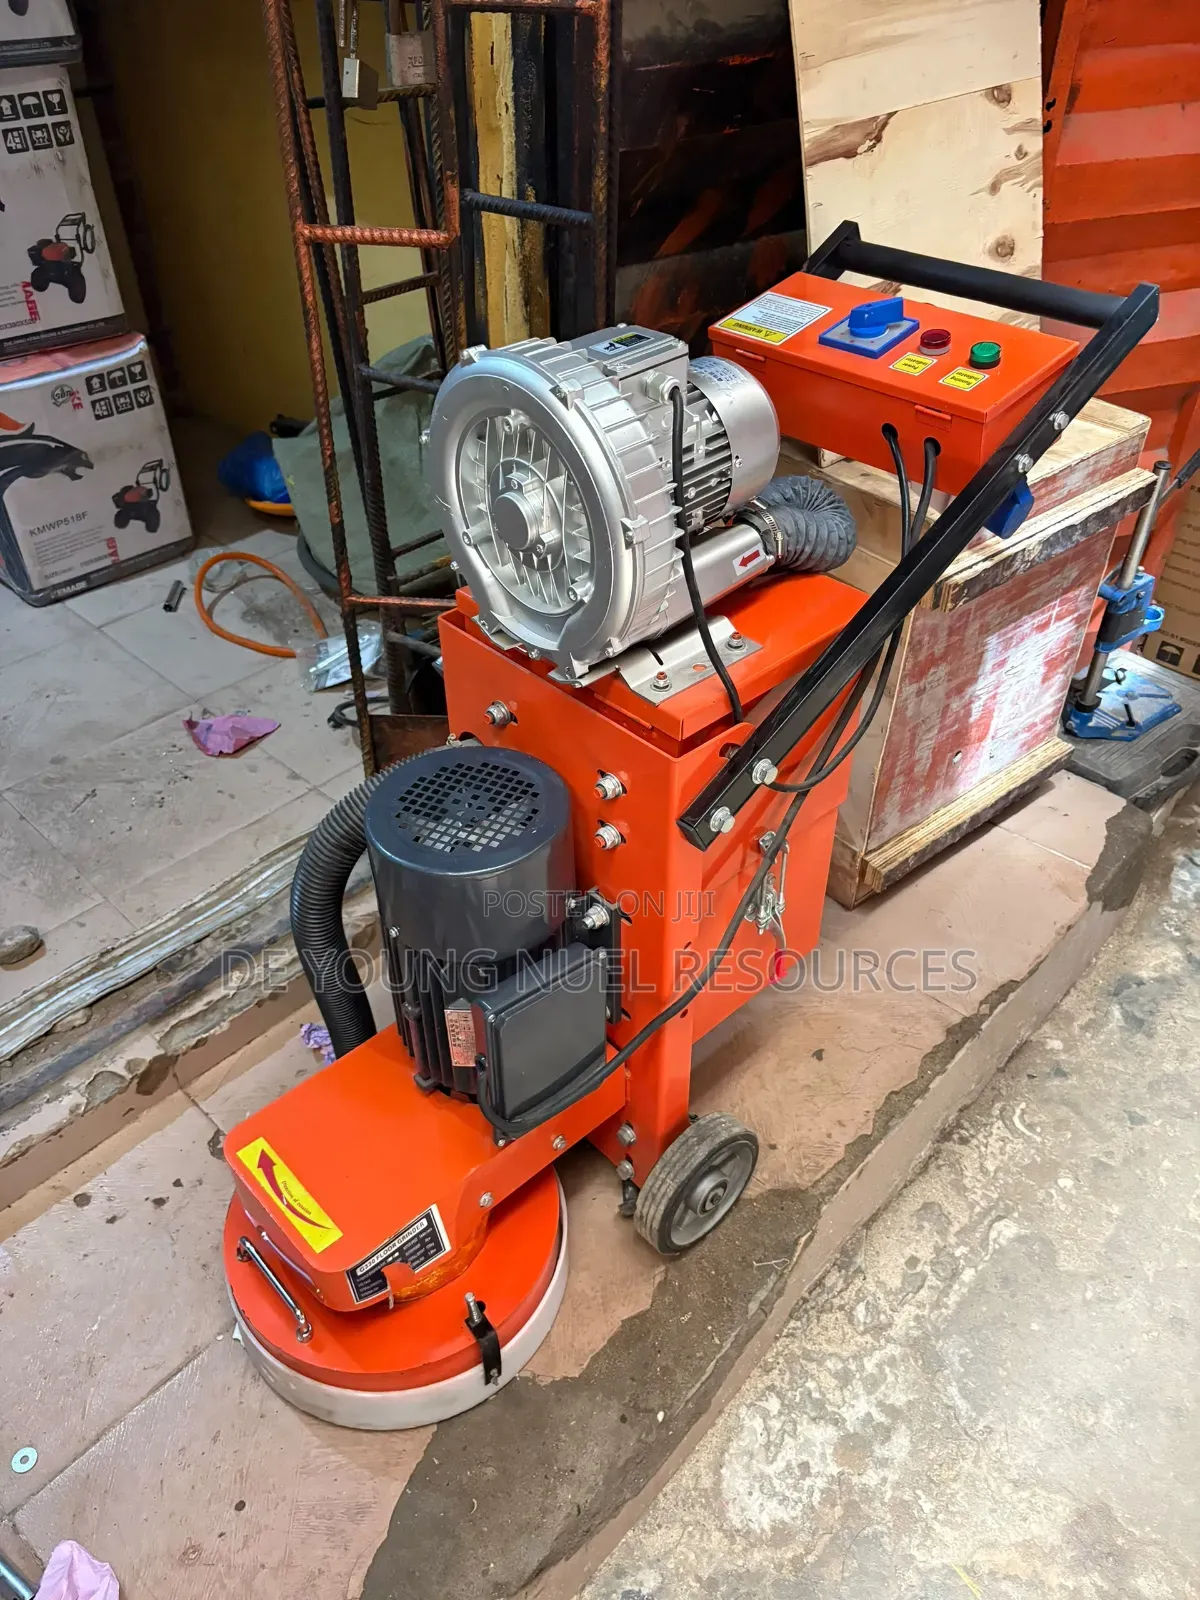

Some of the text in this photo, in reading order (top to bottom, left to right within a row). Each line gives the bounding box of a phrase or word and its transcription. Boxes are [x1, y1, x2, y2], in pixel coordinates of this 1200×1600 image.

[732, 322, 763, 334] WARNING
[902, 362, 919, 370] Power
[950, 375, 972, 386] Running
[29, 511, 89, 537] KMWP518F
[359, 1258, 376, 1273] G330
[376, 1243, 397, 1260] FLOOR
[397, 1221, 425, 1245] GRINDER
